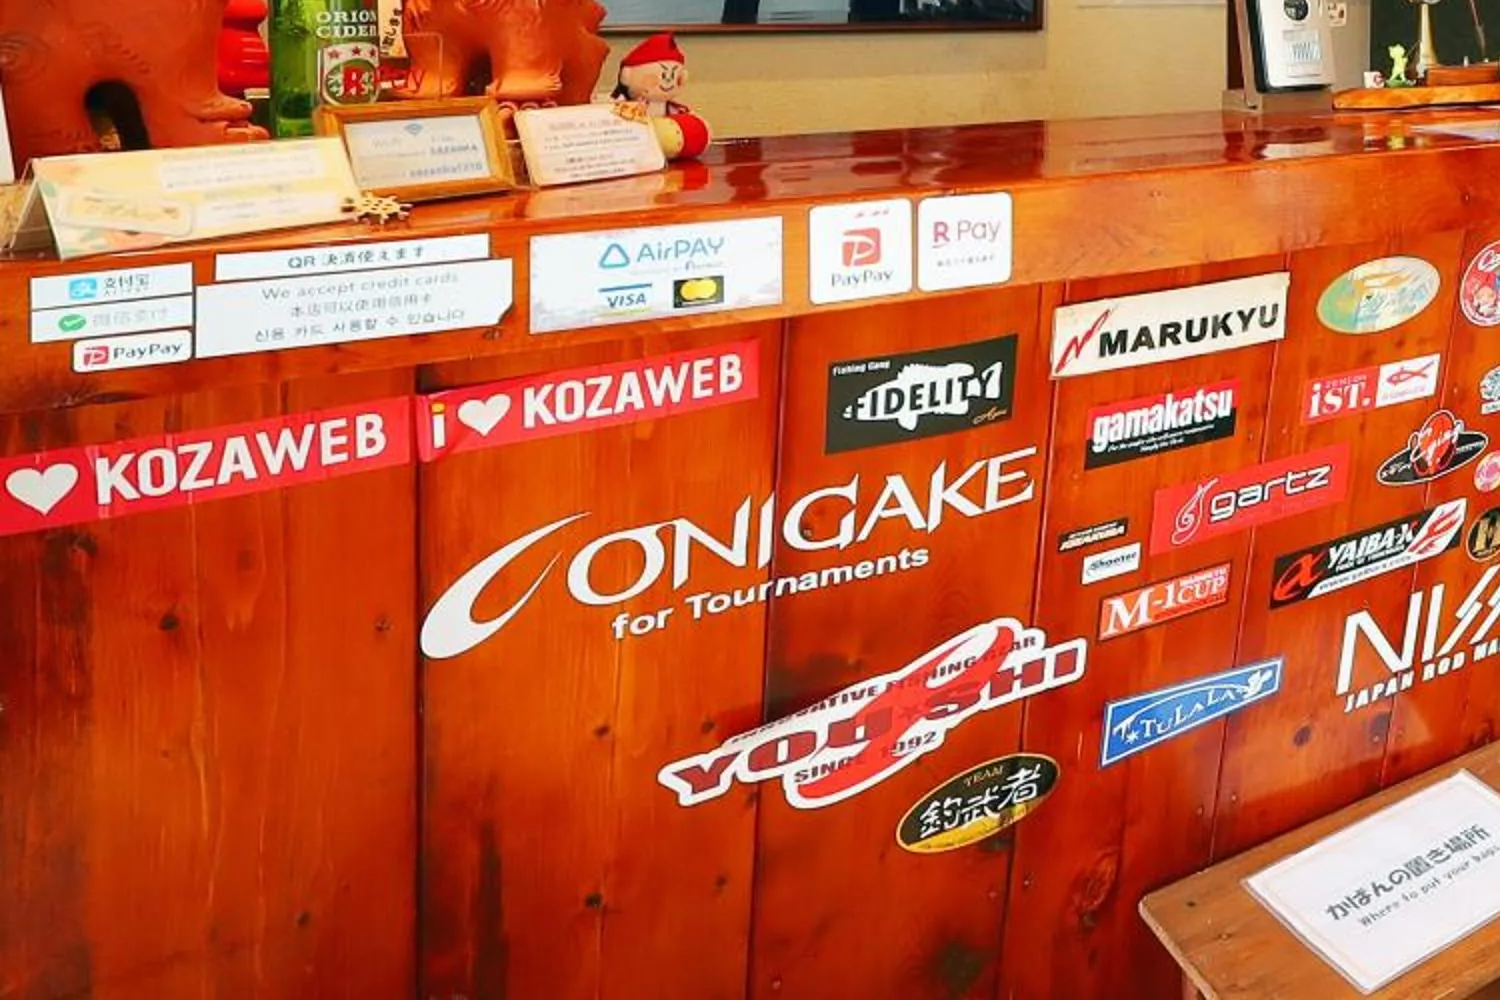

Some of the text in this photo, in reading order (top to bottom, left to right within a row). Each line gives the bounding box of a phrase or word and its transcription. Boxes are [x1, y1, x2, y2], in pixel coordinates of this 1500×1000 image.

[636, 236, 725, 265] AirPAY
[956, 217, 1002, 245] Pay
[262, 270, 459, 301] We accept credit cards
[287, 254, 316, 269] QR
[830, 268, 894, 289] PayPay
[605, 292, 648, 310] VISA
[113, 341, 183, 360] PayPay
[1098, 302, 1280, 358] MARUKYU
[522, 352, 745, 430] KOZAWEB
[1091, 388, 1233, 454] gamakatsu
[93, 411, 388, 505] KOZAWEB
[1208, 460, 1332, 523] gartz
[610, 544, 931, 641] for Tournaments
[1343, 668, 1415, 714] JAPAN
[1422, 651, 1466, 683] ROD
[1325, 822, 1493, 921] かばんの置き場所
[1359, 900, 1400, 928] Where
[1402, 889, 1419, 903] to
[1420, 876, 1442, 895] put
